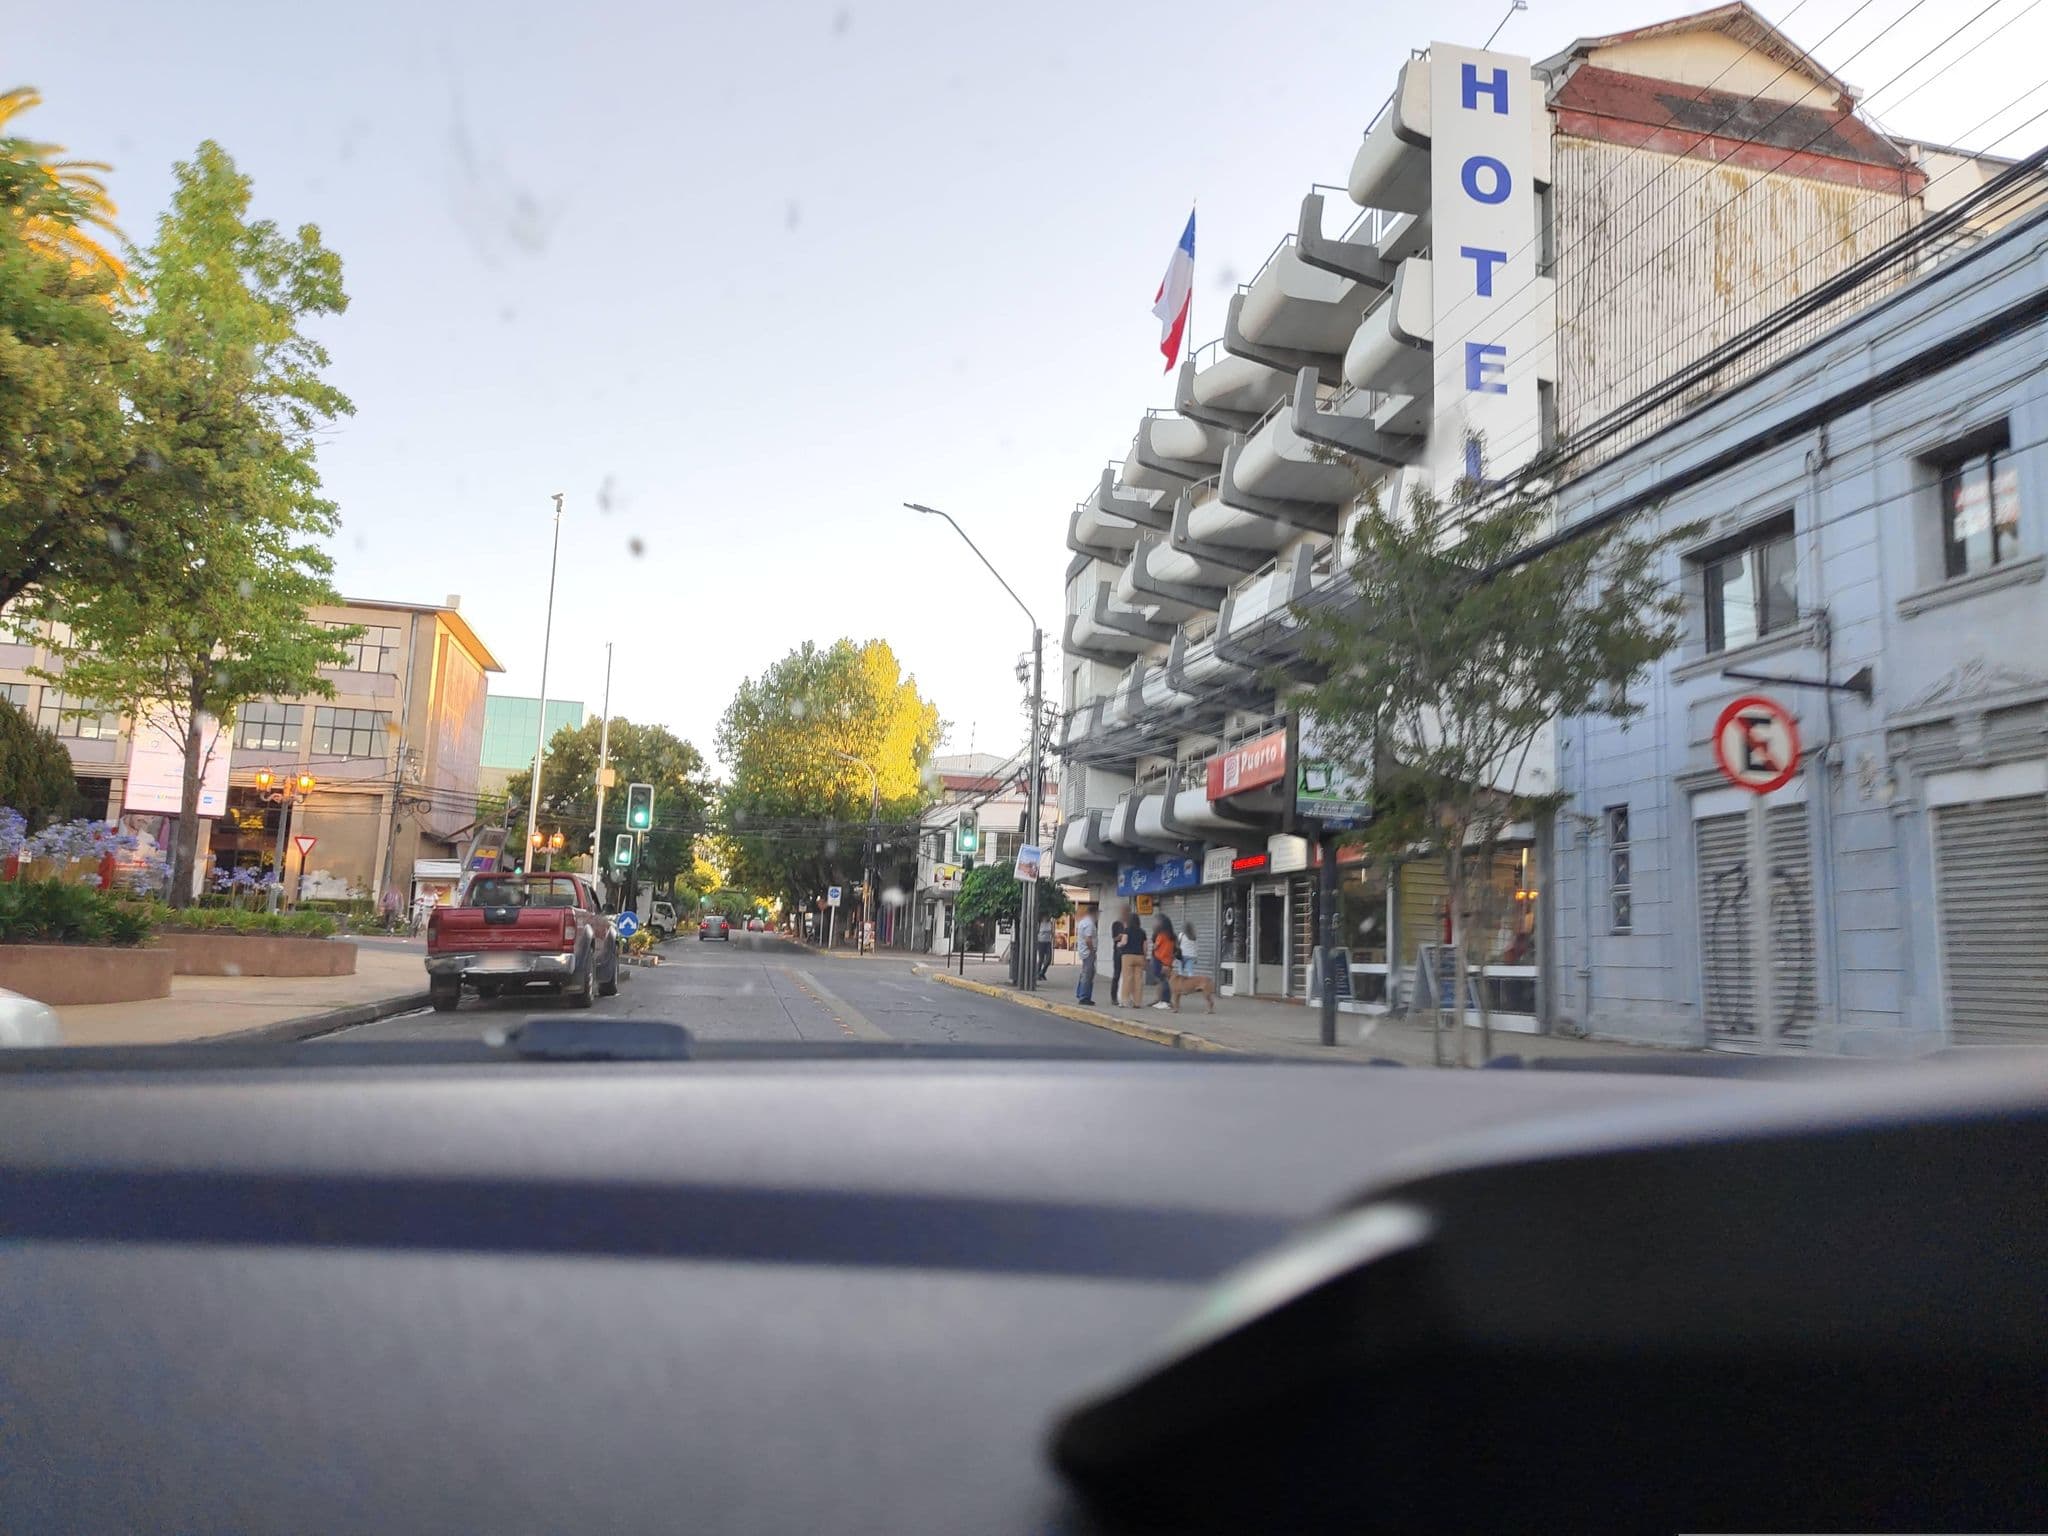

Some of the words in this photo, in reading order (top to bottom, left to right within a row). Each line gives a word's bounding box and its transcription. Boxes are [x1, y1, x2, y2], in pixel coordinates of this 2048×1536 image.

[1461, 62, 1512, 489] HOTEL
[1240, 743, 1277, 773] Puerto
[1742, 716, 1778, 771] E
